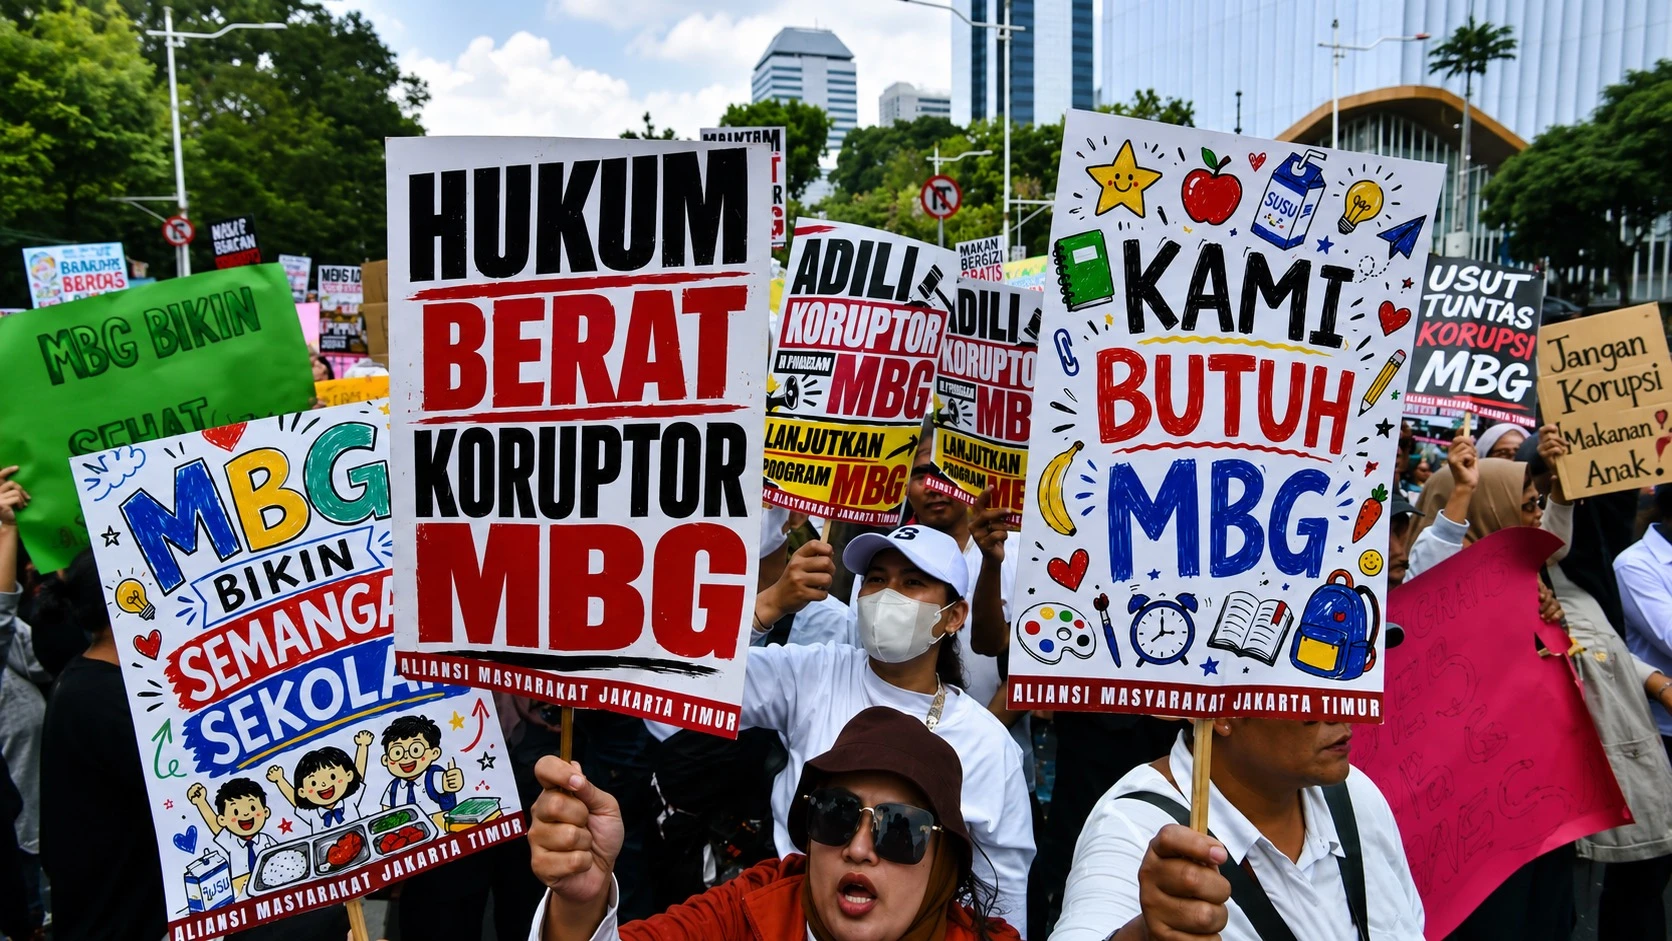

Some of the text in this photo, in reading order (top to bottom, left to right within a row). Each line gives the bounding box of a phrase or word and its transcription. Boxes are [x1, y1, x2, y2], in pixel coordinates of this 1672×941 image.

[409, 148, 747, 282] HUKUM
[1264, 191, 1298, 218] SUSU
[790, 238, 919, 302] ADILI
[959, 238, 998, 257] MAKAN
[1123, 238, 1355, 348] KAMI
[1423, 294, 1534, 330] TUNTAS
[1428, 265, 1532, 300] USUT
[37, 286, 262, 386] MBG BIKIN
[422, 285, 748, 411] BERAT
[785, 301, 941, 354] KORUPTOR
[1416, 321, 1536, 361] KORUPSI
[1547, 334, 1648, 373] Jangan
[826, 353, 935, 419] MBG
[1096, 347, 1355, 455] BUTUH
[1415, 350, 1533, 402] MBG
[1557, 363, 1663, 415] Korupsi
[414, 422, 748, 519] KORUPTOR
[765, 422, 884, 459] LANJUTKAN
[943, 434, 1021, 474] LANJUTKAN
[1558, 422, 1654, 455] Makanan
[119, 422, 390, 595] MBG
[829, 463, 908, 506] MBG
[1108, 459, 1331, 583] MBG
[214, 538, 354, 613] BIKIN
[416, 522, 747, 659] MBG
[200, 644, 450, 767] SEKOLA
[401, 658, 736, 732] ALIANSI MASYARAKAT JAKARTA TIMUR
[1012, 682, 1381, 718] ALIANSI MASYARAKAT JAKARTA TIMUR
[174, 817, 523, 941] ALIANSI MASYARAKAT JAKARTA TIMUR
